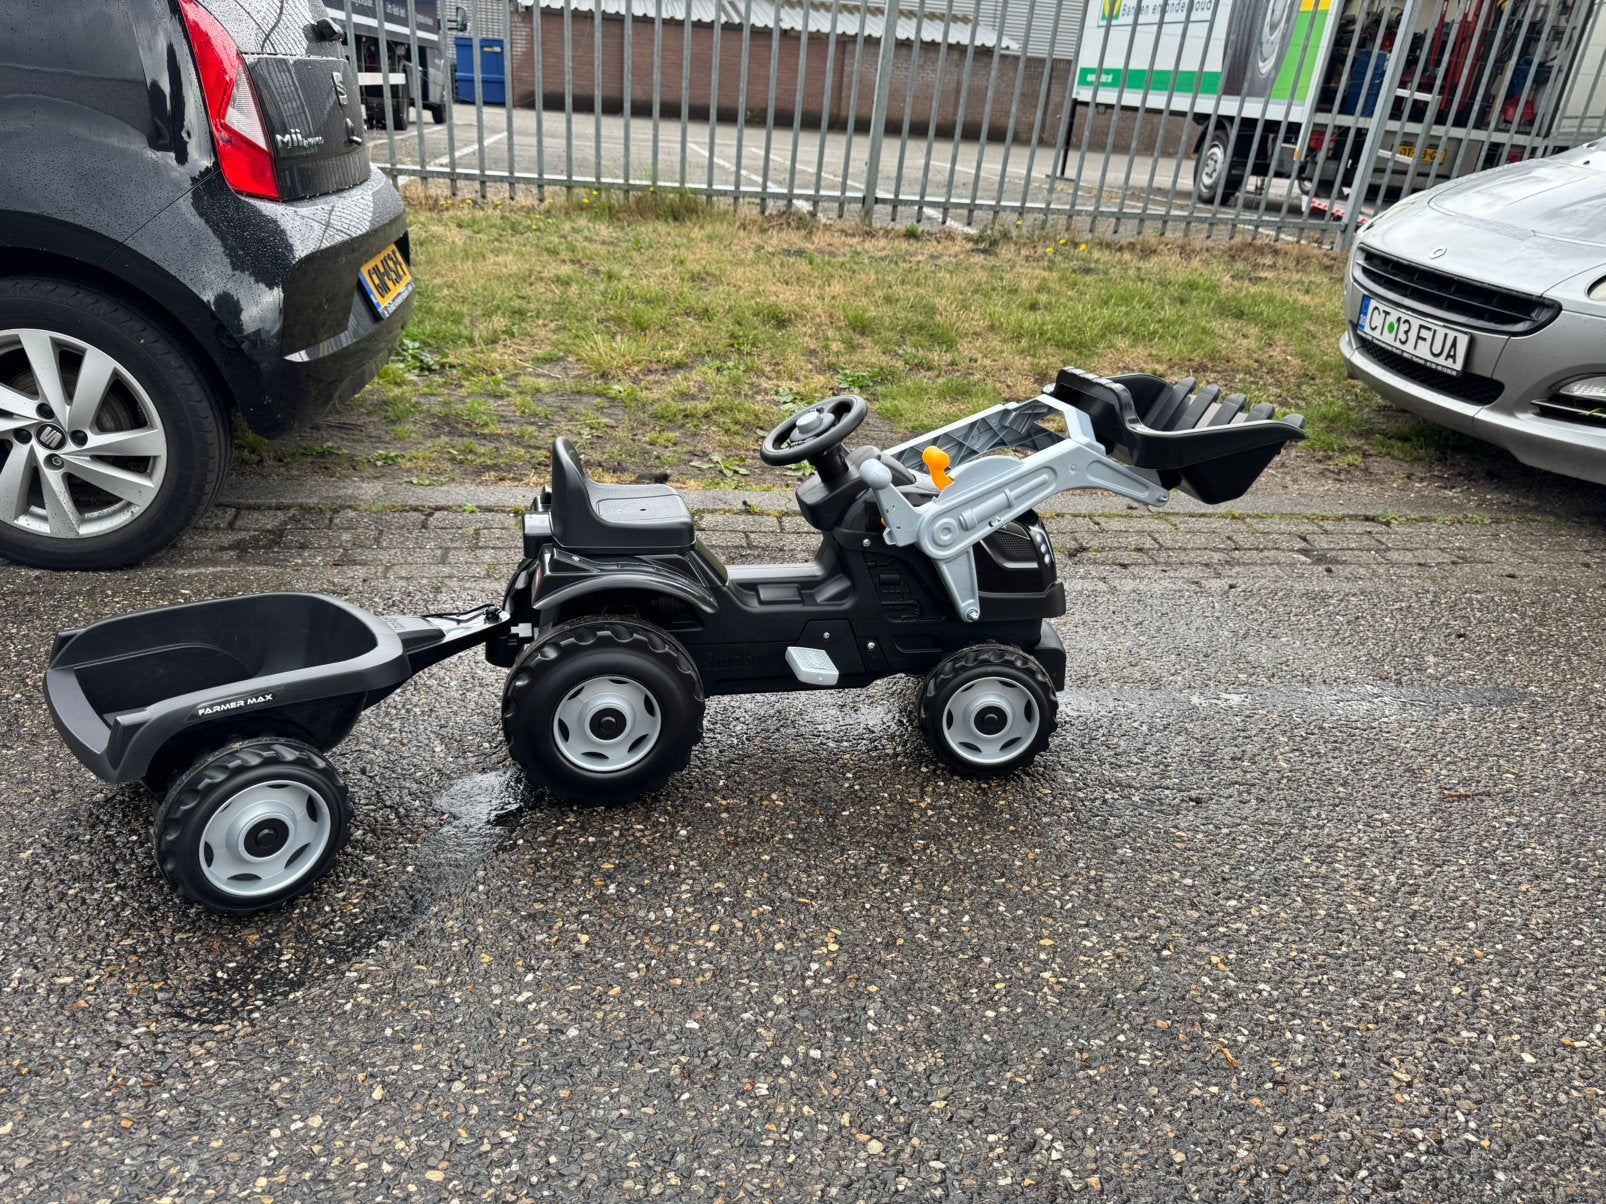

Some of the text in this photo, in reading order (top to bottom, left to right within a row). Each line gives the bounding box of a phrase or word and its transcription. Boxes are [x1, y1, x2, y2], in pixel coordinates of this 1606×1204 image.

[1369, 306, 1391, 336] CT
[1393, 316, 1412, 345] 13
[1414, 324, 1458, 364] FUA
[198, 693, 273, 716] FARMER MAX
